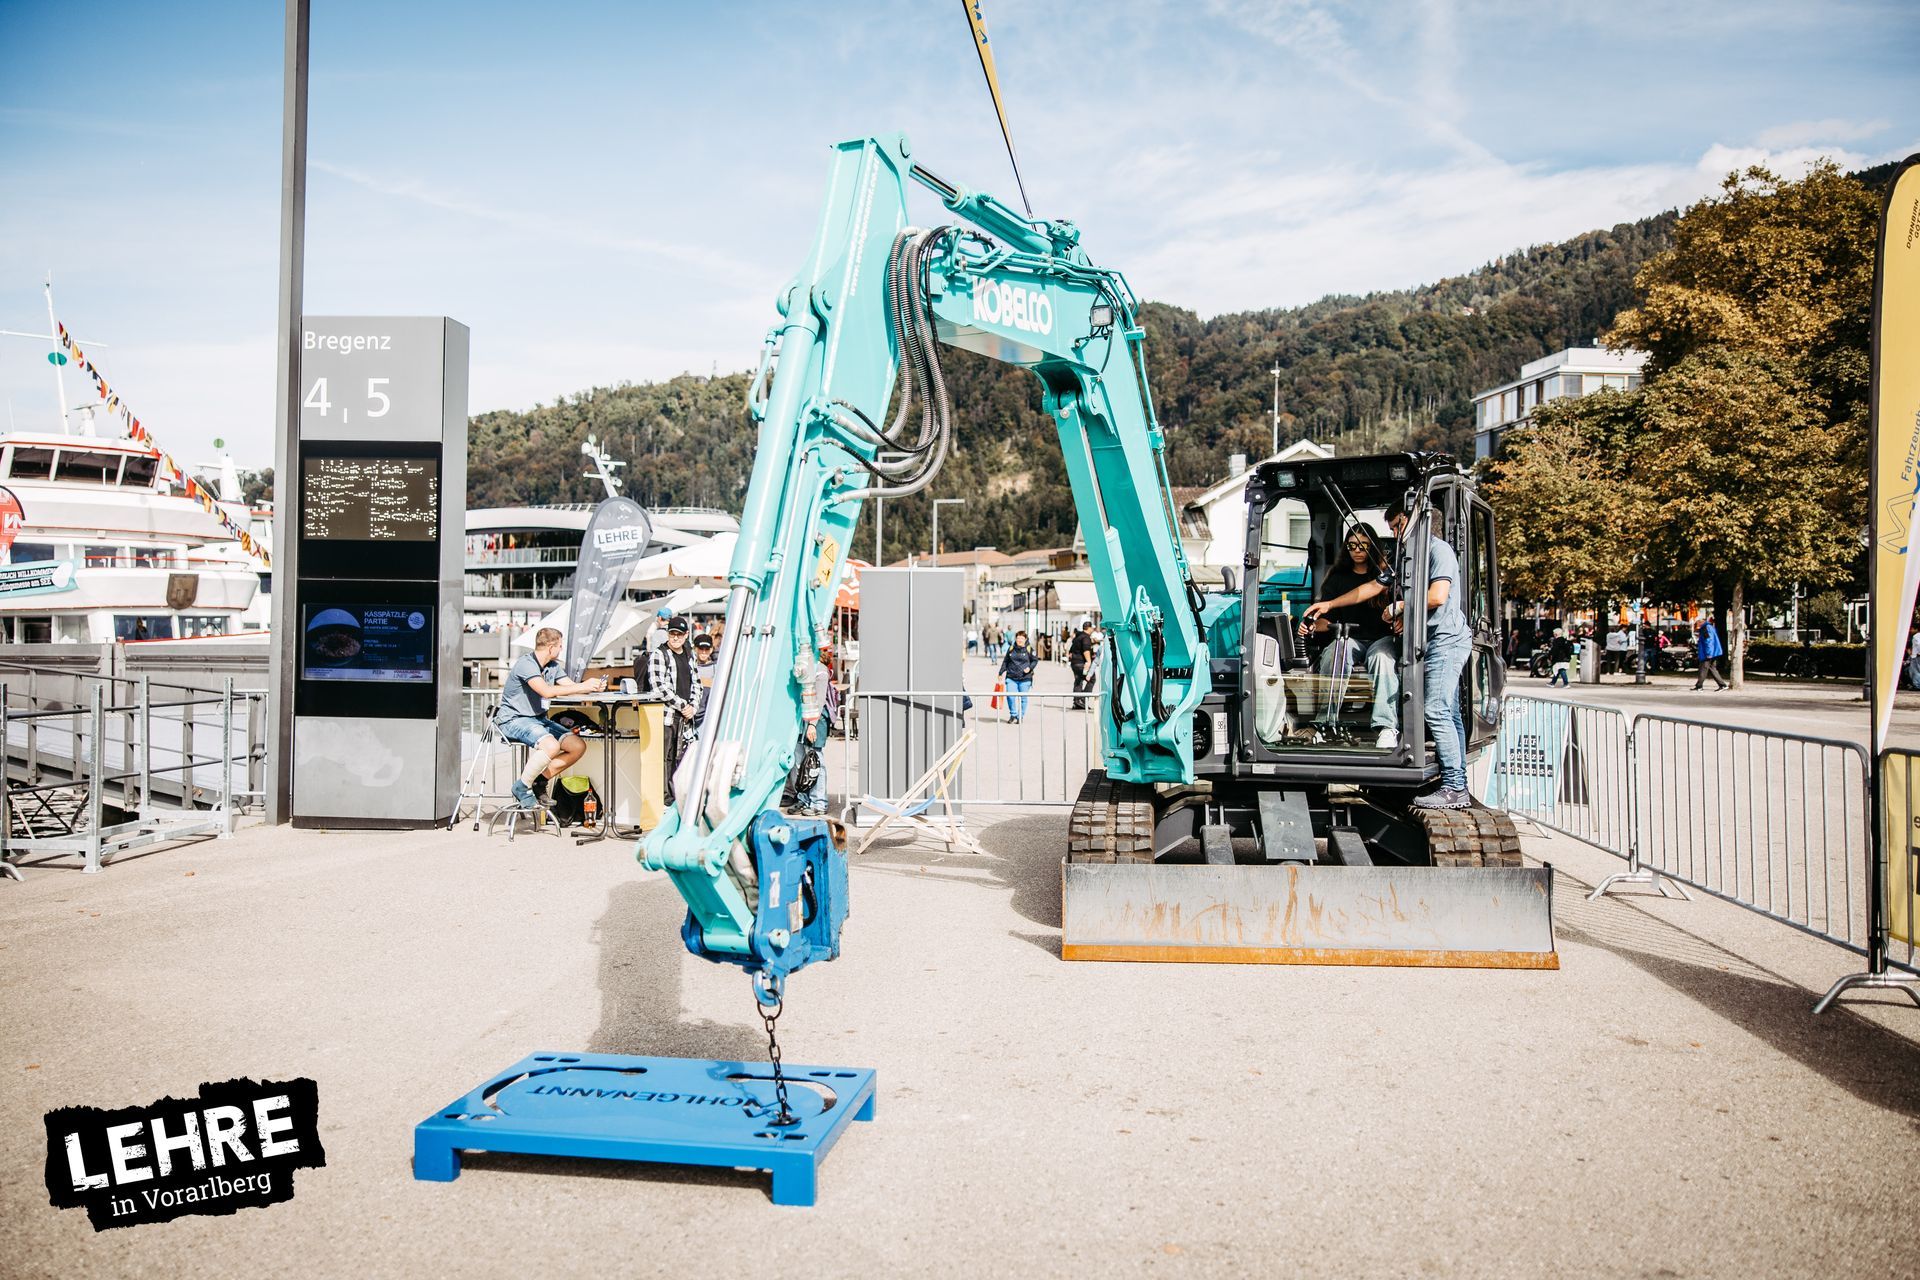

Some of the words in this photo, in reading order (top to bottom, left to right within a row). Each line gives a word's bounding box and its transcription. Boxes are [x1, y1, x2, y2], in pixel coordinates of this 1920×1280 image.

[973, 275, 1053, 335] KOBELCO
[304, 331, 391, 355] Bregenz
[367, 378, 391, 418] 5
[598, 530, 639, 544] LEHRE
